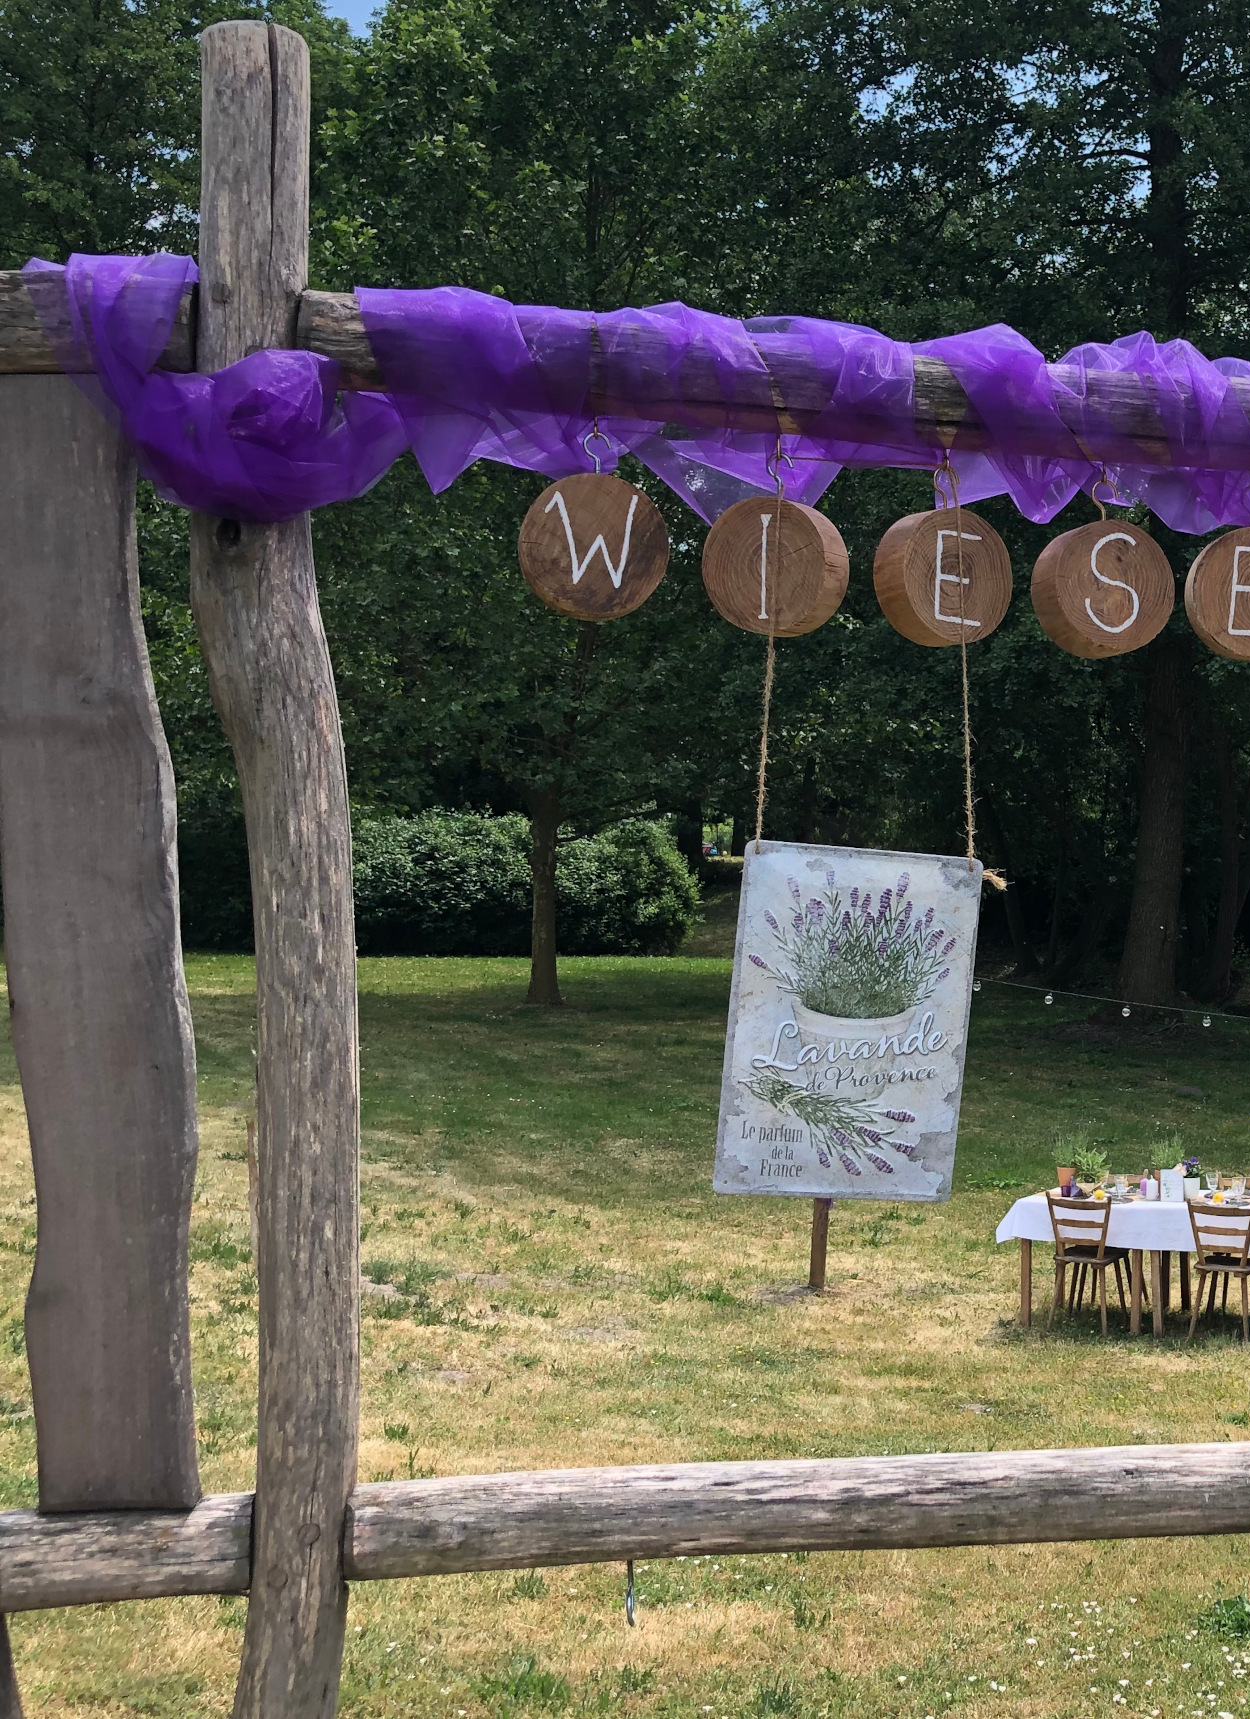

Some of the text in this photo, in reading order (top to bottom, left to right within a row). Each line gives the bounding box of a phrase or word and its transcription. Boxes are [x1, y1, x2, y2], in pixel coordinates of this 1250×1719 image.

[751, 1011, 949, 1072] Lavande
[805, 1065, 938, 1093] de Provence
[741, 1120, 803, 1144] Le parfum
[771, 1145, 794, 1161] de la
[760, 1158, 803, 1178] France
